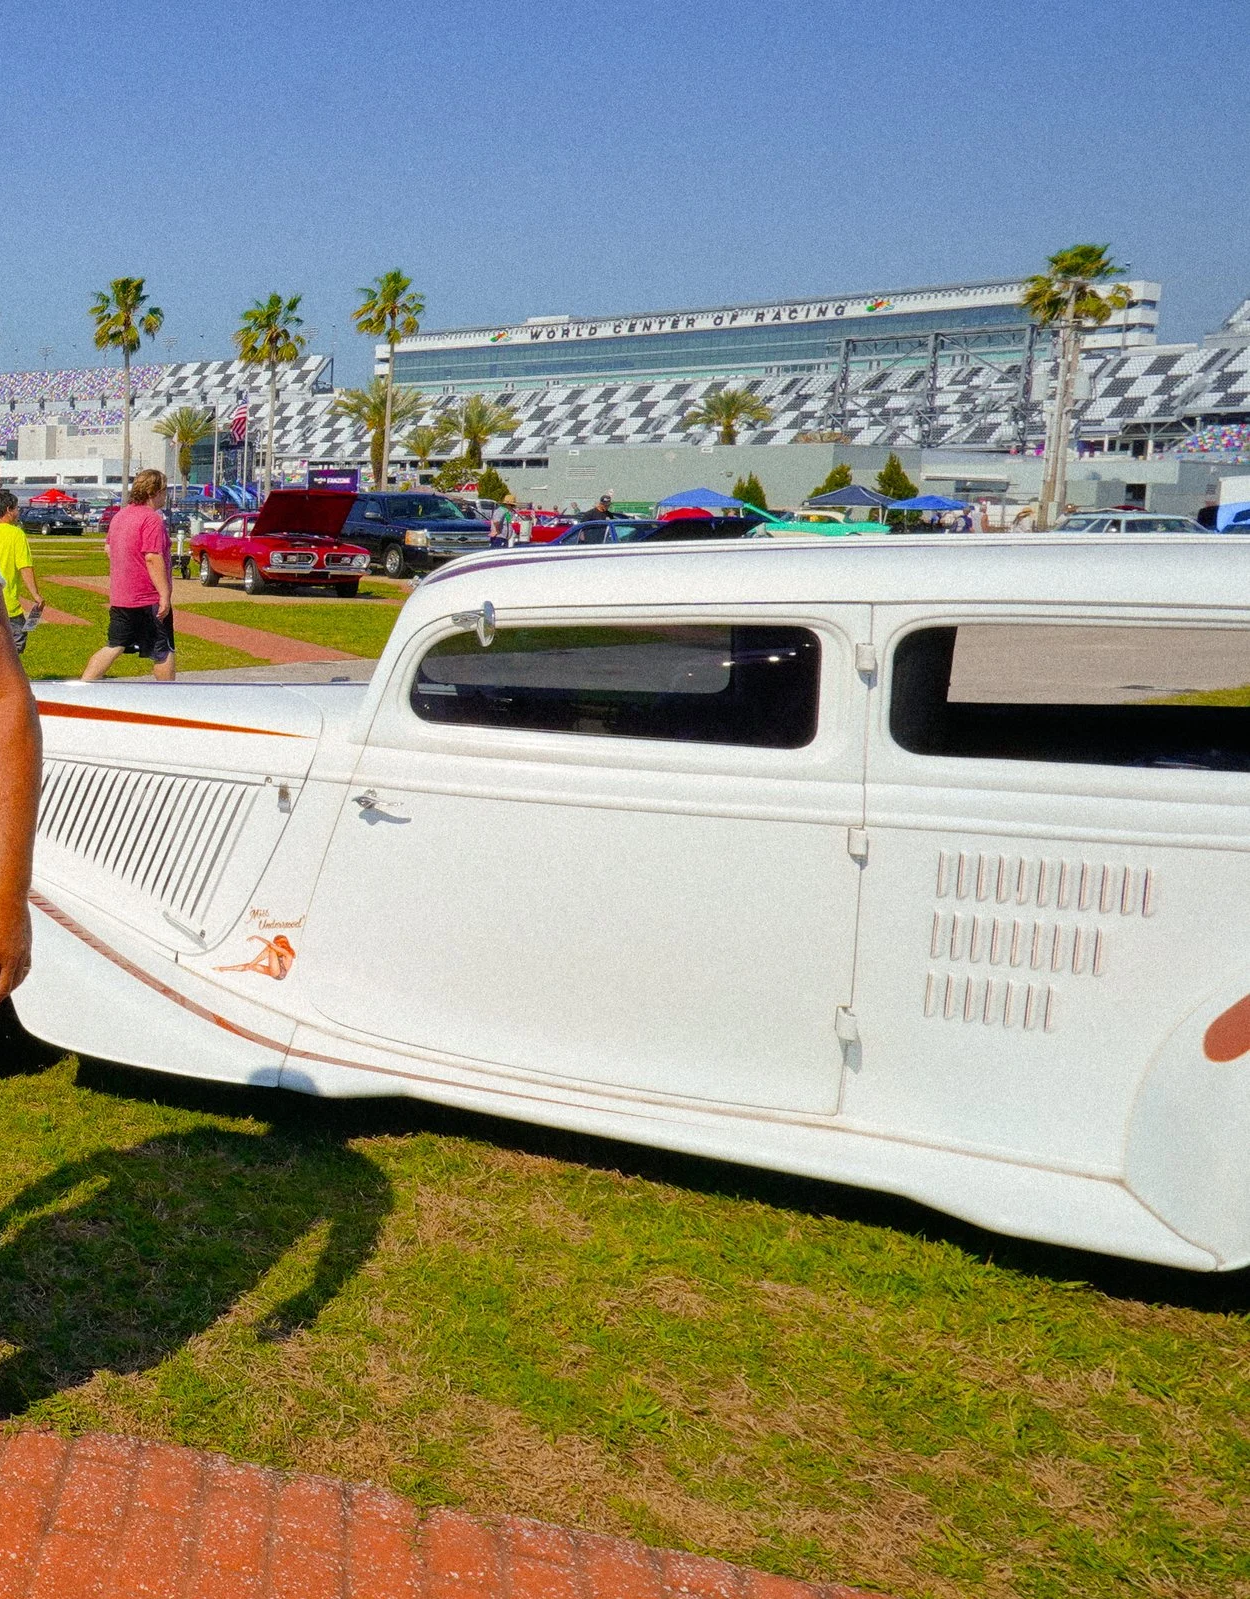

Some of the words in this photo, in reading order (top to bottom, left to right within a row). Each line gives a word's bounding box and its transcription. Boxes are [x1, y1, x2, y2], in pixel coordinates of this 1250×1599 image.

[530, 326, 598, 341] WORLD
[613, 317, 696, 334] CENTER
[713, 312, 739, 326] OF
[754, 304, 846, 323] RACING
